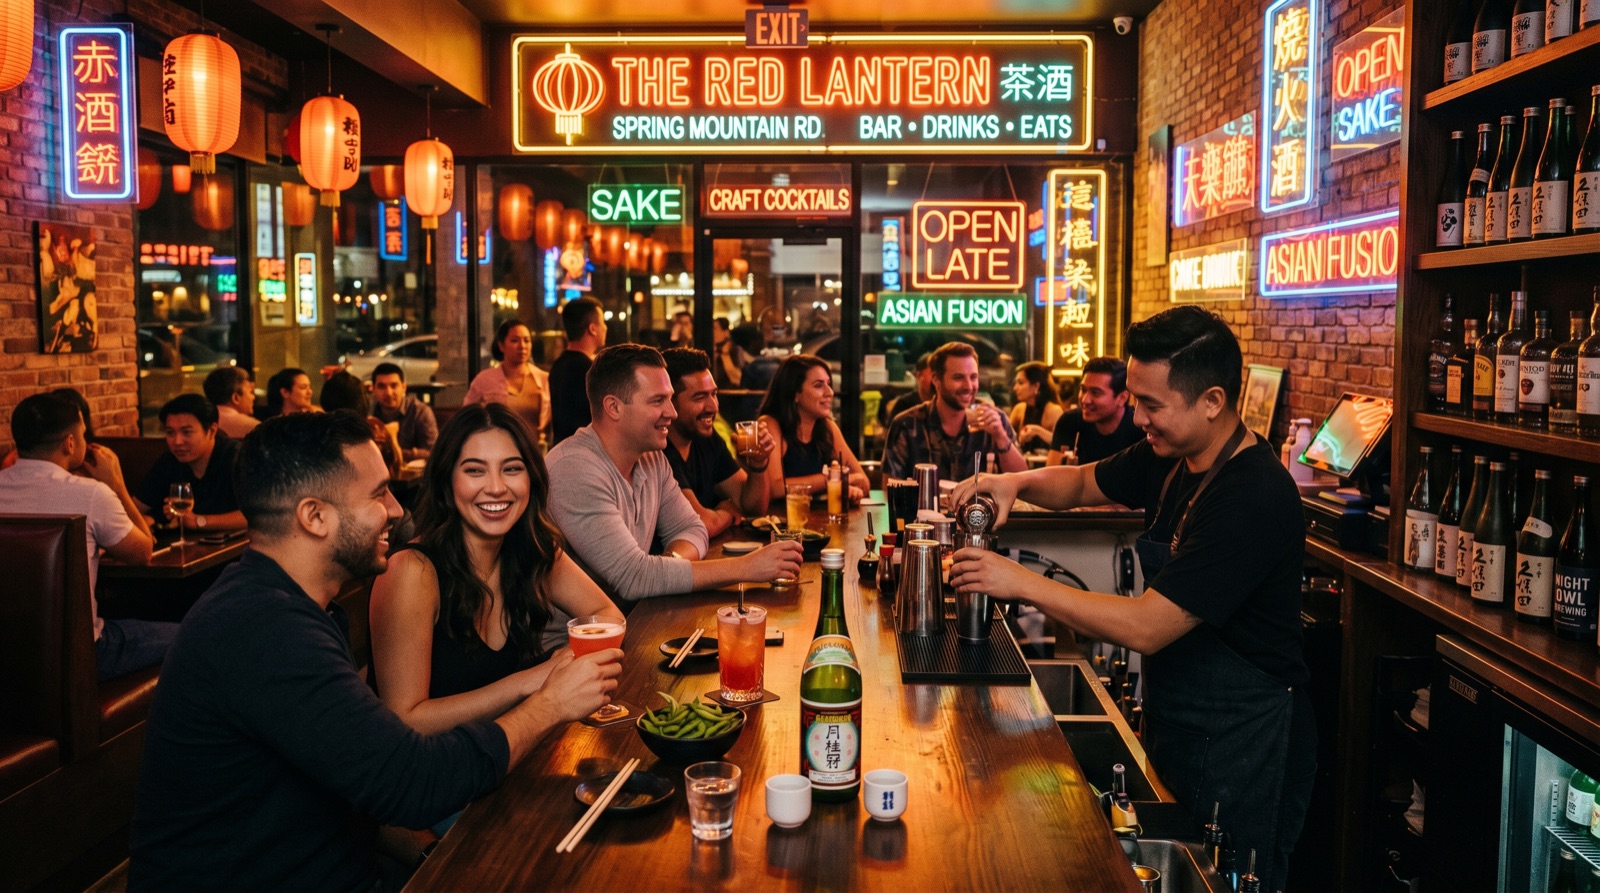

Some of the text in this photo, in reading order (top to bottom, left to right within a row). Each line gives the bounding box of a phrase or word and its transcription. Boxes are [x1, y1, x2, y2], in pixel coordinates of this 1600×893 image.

[756, 12, 800, 45] EXIT
[1336, 26, 1405, 98] OPEN
[612, 56, 990, 106] THE RED LANTERN
[1000, 63, 1073, 102] 茶酒
[612, 115, 685, 140] SPRING
[689, 115, 789, 140] MOUNTAIN
[859, 115, 902, 139] BAR
[922, 115, 1000, 139] DRINKS
[1020, 115, 1073, 139] EATS
[1338, 87, 1397, 142] SAKE
[591, 188, 682, 221] SAKE
[709, 188, 850, 211] CRAFT COCKTAILS
[921, 210, 1017, 243] OPEN
[926, 248, 1010, 281] LATE
[1266, 239, 1321, 285] ASIAN
[881, 299, 1023, 324] ASIAN FUSION
[1555, 573, 1591, 591] NIGHT
[1556, 588, 1586, 606] OWL
[1554, 602, 1587, 617] BREWING
